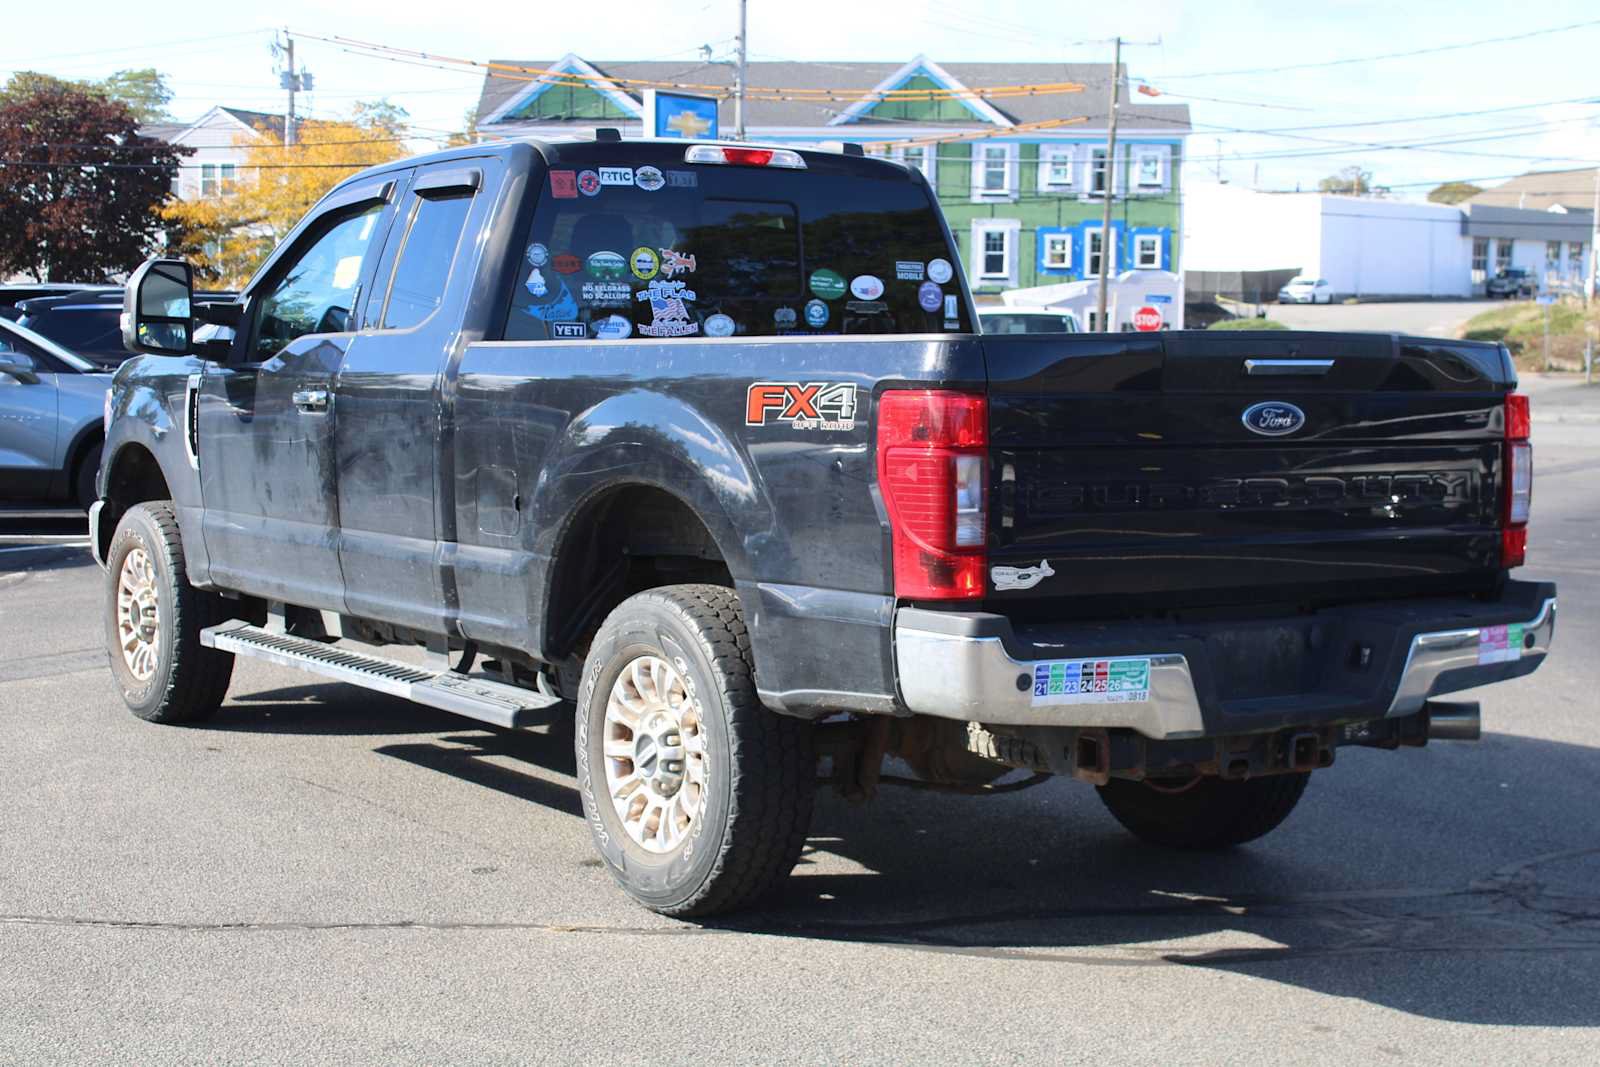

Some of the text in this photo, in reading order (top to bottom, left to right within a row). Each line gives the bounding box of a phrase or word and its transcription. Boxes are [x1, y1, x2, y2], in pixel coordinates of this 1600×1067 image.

[601, 171, 631, 181] RTIC
[636, 288, 696, 301] THE FLAG
[1135, 314, 1161, 327] STOP
[555, 326, 584, 336] YETI
[638, 324, 658, 336] THE
[658, 322, 698, 336] FALLEN
[746, 382, 857, 426] FX4
[1259, 408, 1293, 427] Ford
[1036, 680, 1120, 695] 21 22 23 24 25 26
